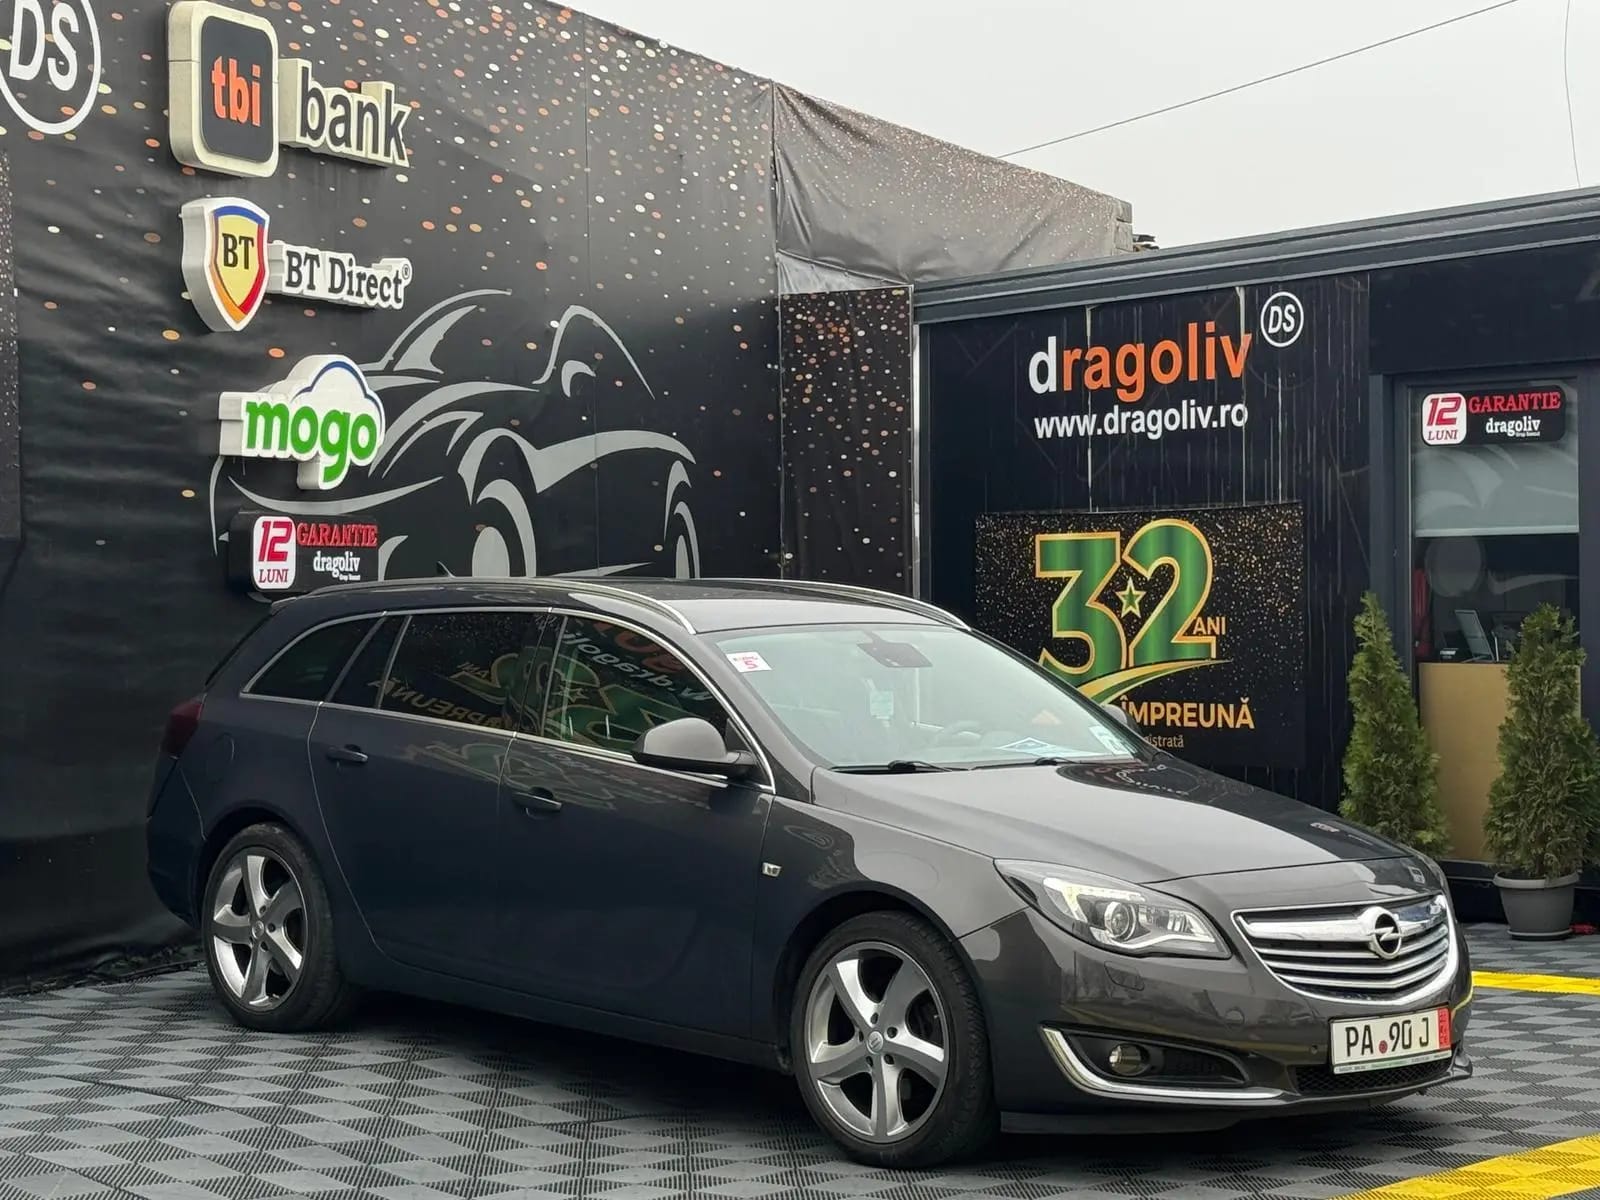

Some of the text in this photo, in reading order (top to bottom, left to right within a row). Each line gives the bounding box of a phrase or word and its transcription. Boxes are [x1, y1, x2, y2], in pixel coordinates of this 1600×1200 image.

[9, 0, 79, 91] DS
[211, 55, 407, 161] tbi bank
[222, 232, 255, 270] BT
[286, 250, 320, 290] BT
[1268, 303, 1296, 334] DS
[1028, 320, 1253, 402] dragoliv
[1034, 399, 1249, 440] www.dragoliv.ro
[1427, 391, 1562, 426] 12 GARANTIE
[1485, 416, 1541, 437] dragoliv
[245, 401, 378, 483] mogo
[1427, 429, 1458, 441] LUNI
[258, 520, 378, 562] 12 GARANTIE
[259, 568, 289, 584] LUNI
[313, 550, 361, 578] dragoliv
[1035, 517, 1226, 688] 32 ANI
[1345, 1024, 1374, 1057] PA
[1389, 1020, 1412, 1052] 90
[1419, 1017, 1429, 1047] J
